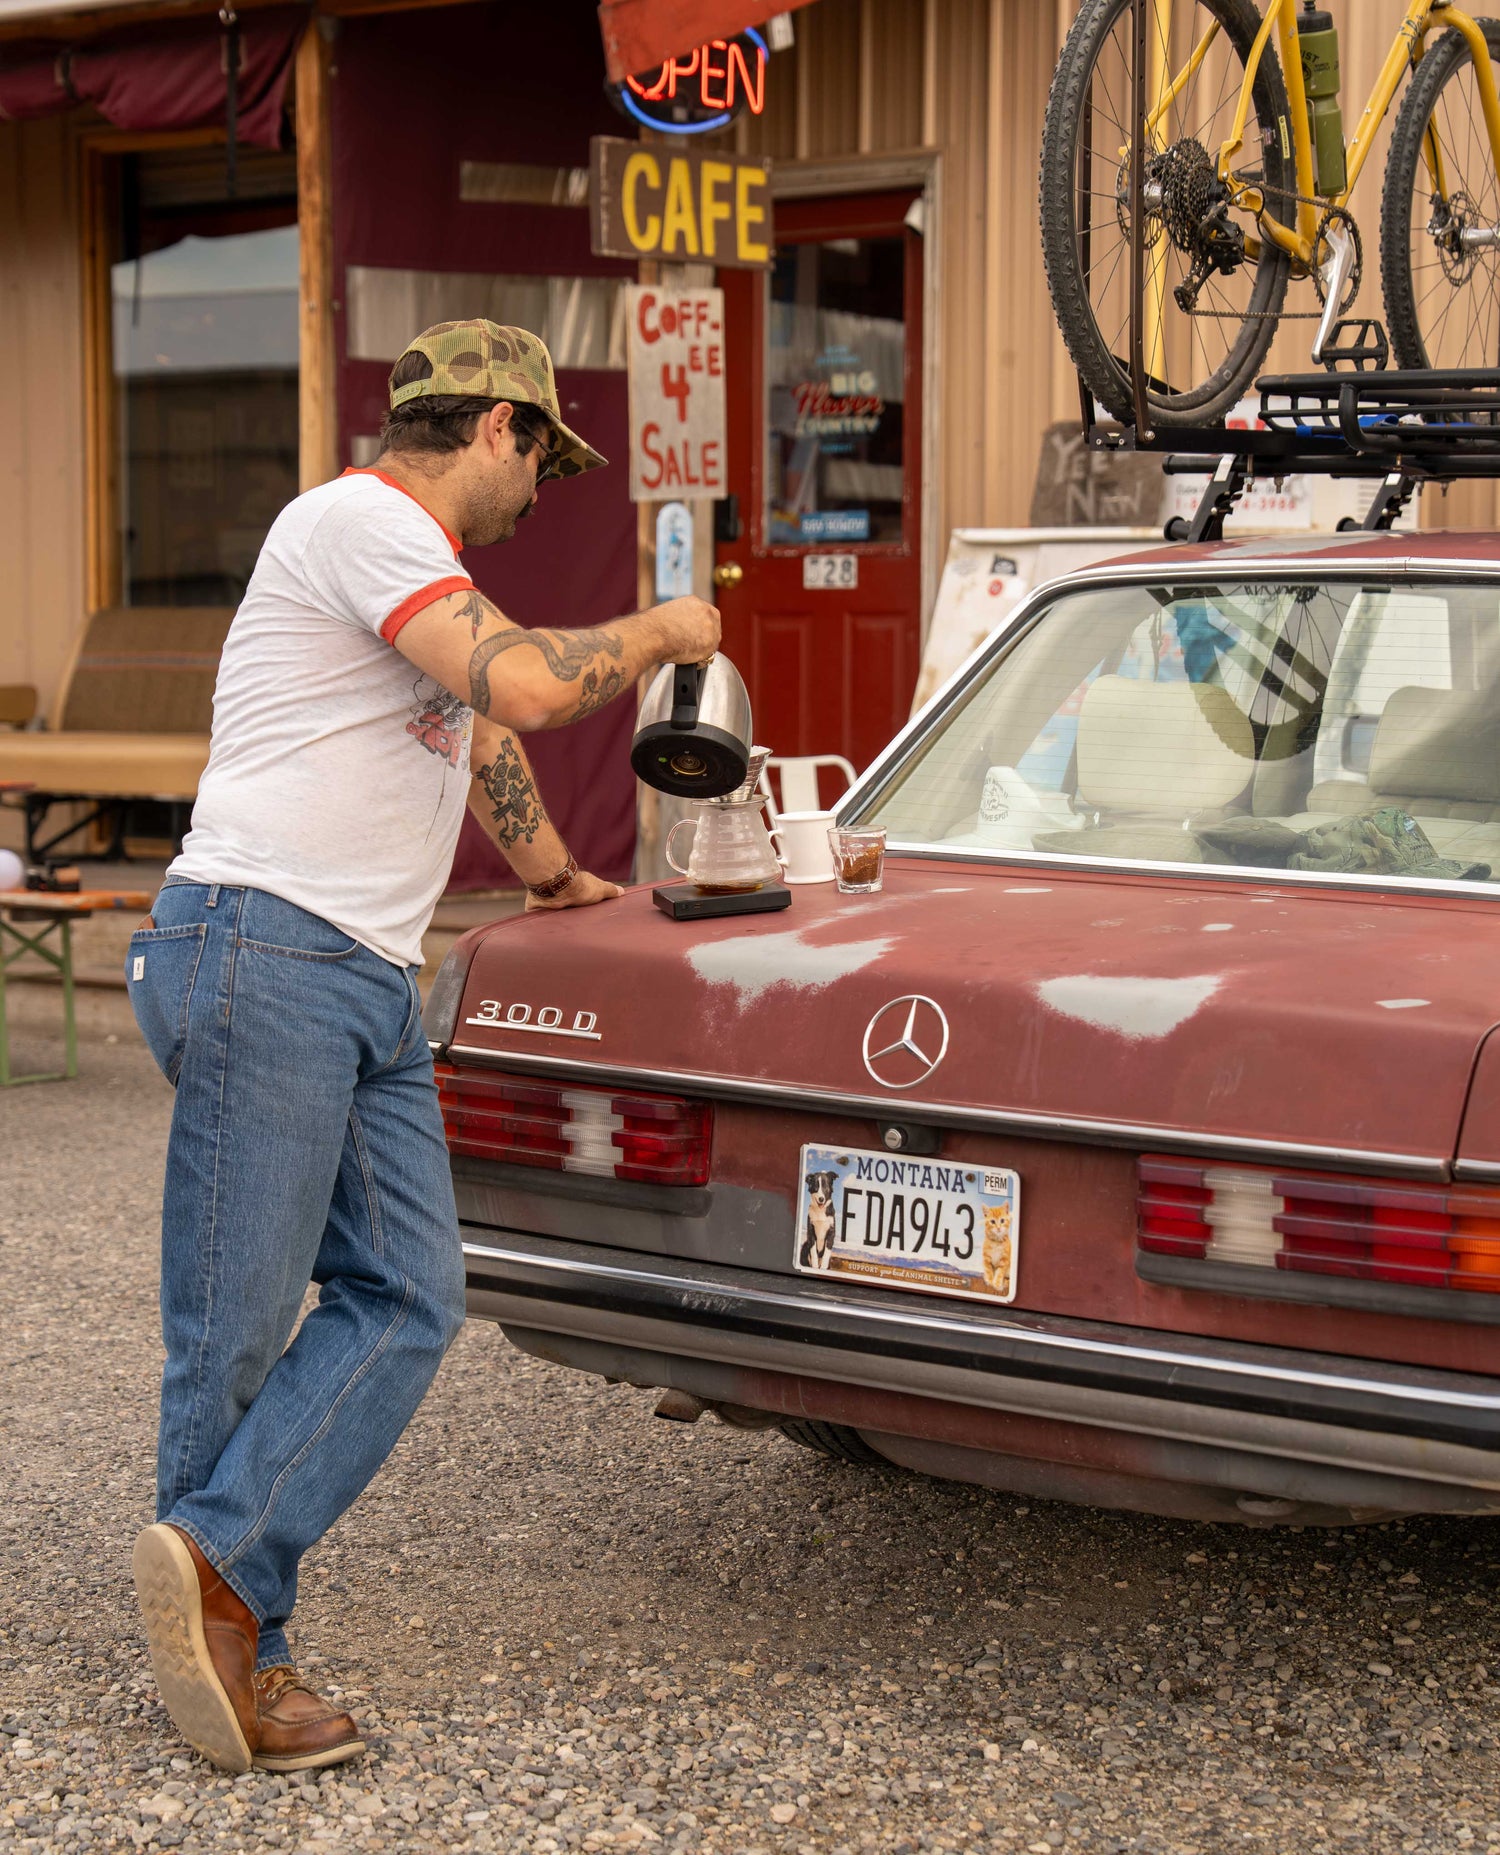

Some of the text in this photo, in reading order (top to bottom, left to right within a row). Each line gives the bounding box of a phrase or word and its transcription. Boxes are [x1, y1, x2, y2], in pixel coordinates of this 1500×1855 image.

[621, 152, 769, 263] CAFE
[689, 345, 721, 376] EE
[661, 363, 690, 423] 4
[641, 422, 719, 489] SALE
[476, 1000, 597, 1032] 300 D
[856, 1156, 966, 1193] MONTANA
[984, 1175, 1007, 1190] PERM
[840, 1187, 975, 1260] FDA943
[847, 1263, 878, 1273] SUPPORT
[905, 1271, 932, 1281] ANIMAL
[934, 1276, 965, 1286] SHELTE
